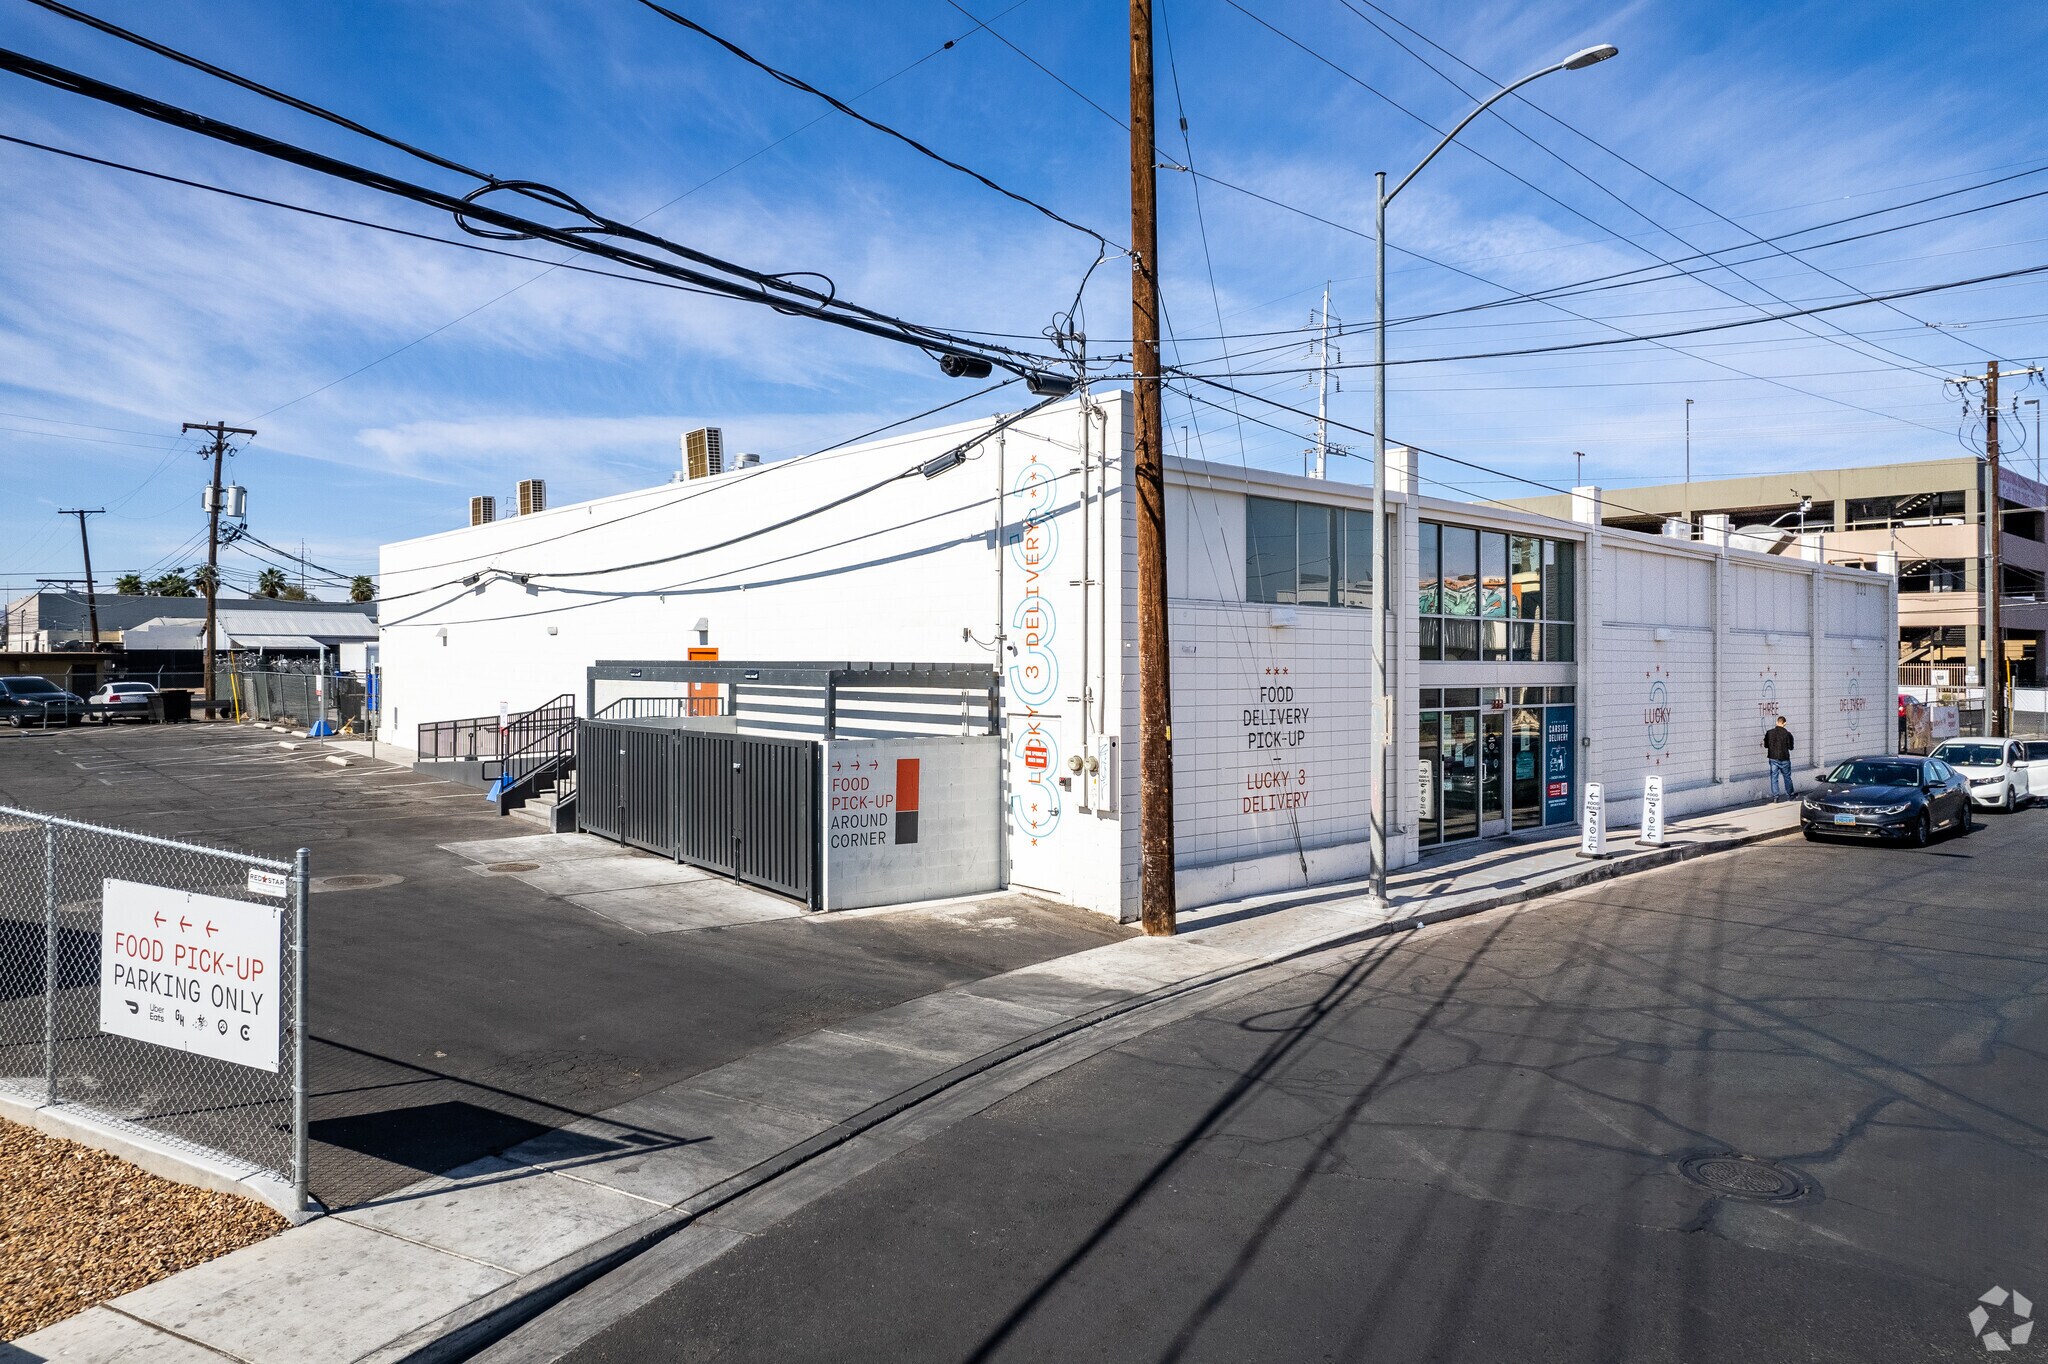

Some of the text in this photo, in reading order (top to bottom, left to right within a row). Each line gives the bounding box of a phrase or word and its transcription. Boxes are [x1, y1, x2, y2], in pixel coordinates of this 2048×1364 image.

[1026, 519, 1040, 647] DELIVERY
[1026, 665, 1039, 679] 3
[1260, 686, 1294, 703] FOOD
[1758, 701, 1779, 716] THREE
[1840, 697, 1867, 711] DELIVERY
[1243, 707, 1309, 727] DELIVERY
[1644, 707, 1671, 724] LUCKY
[1548, 724, 1569, 733] CARSIDE
[1027, 705, 1041, 784] LCKY
[1248, 730, 1305, 749] PICK-UP
[1548, 733, 1568, 742] DELIVERY
[832, 777, 870, 792] FOOD
[1247, 769, 1306, 790] LUCKY 3
[832, 794, 894, 811] PICK-UP
[1243, 791, 1309, 814] DELIVERY
[831, 813, 888, 830] AROUND
[831, 831, 887, 849] CORNER
[250, 874, 285, 886] RED STAR
[115, 932, 264, 982] FOOD PICK-UP
[114, 963, 264, 1016] PARKING ONLY
[149, 1004, 165, 1014] Uber
[149, 1012, 165, 1022] Eats
